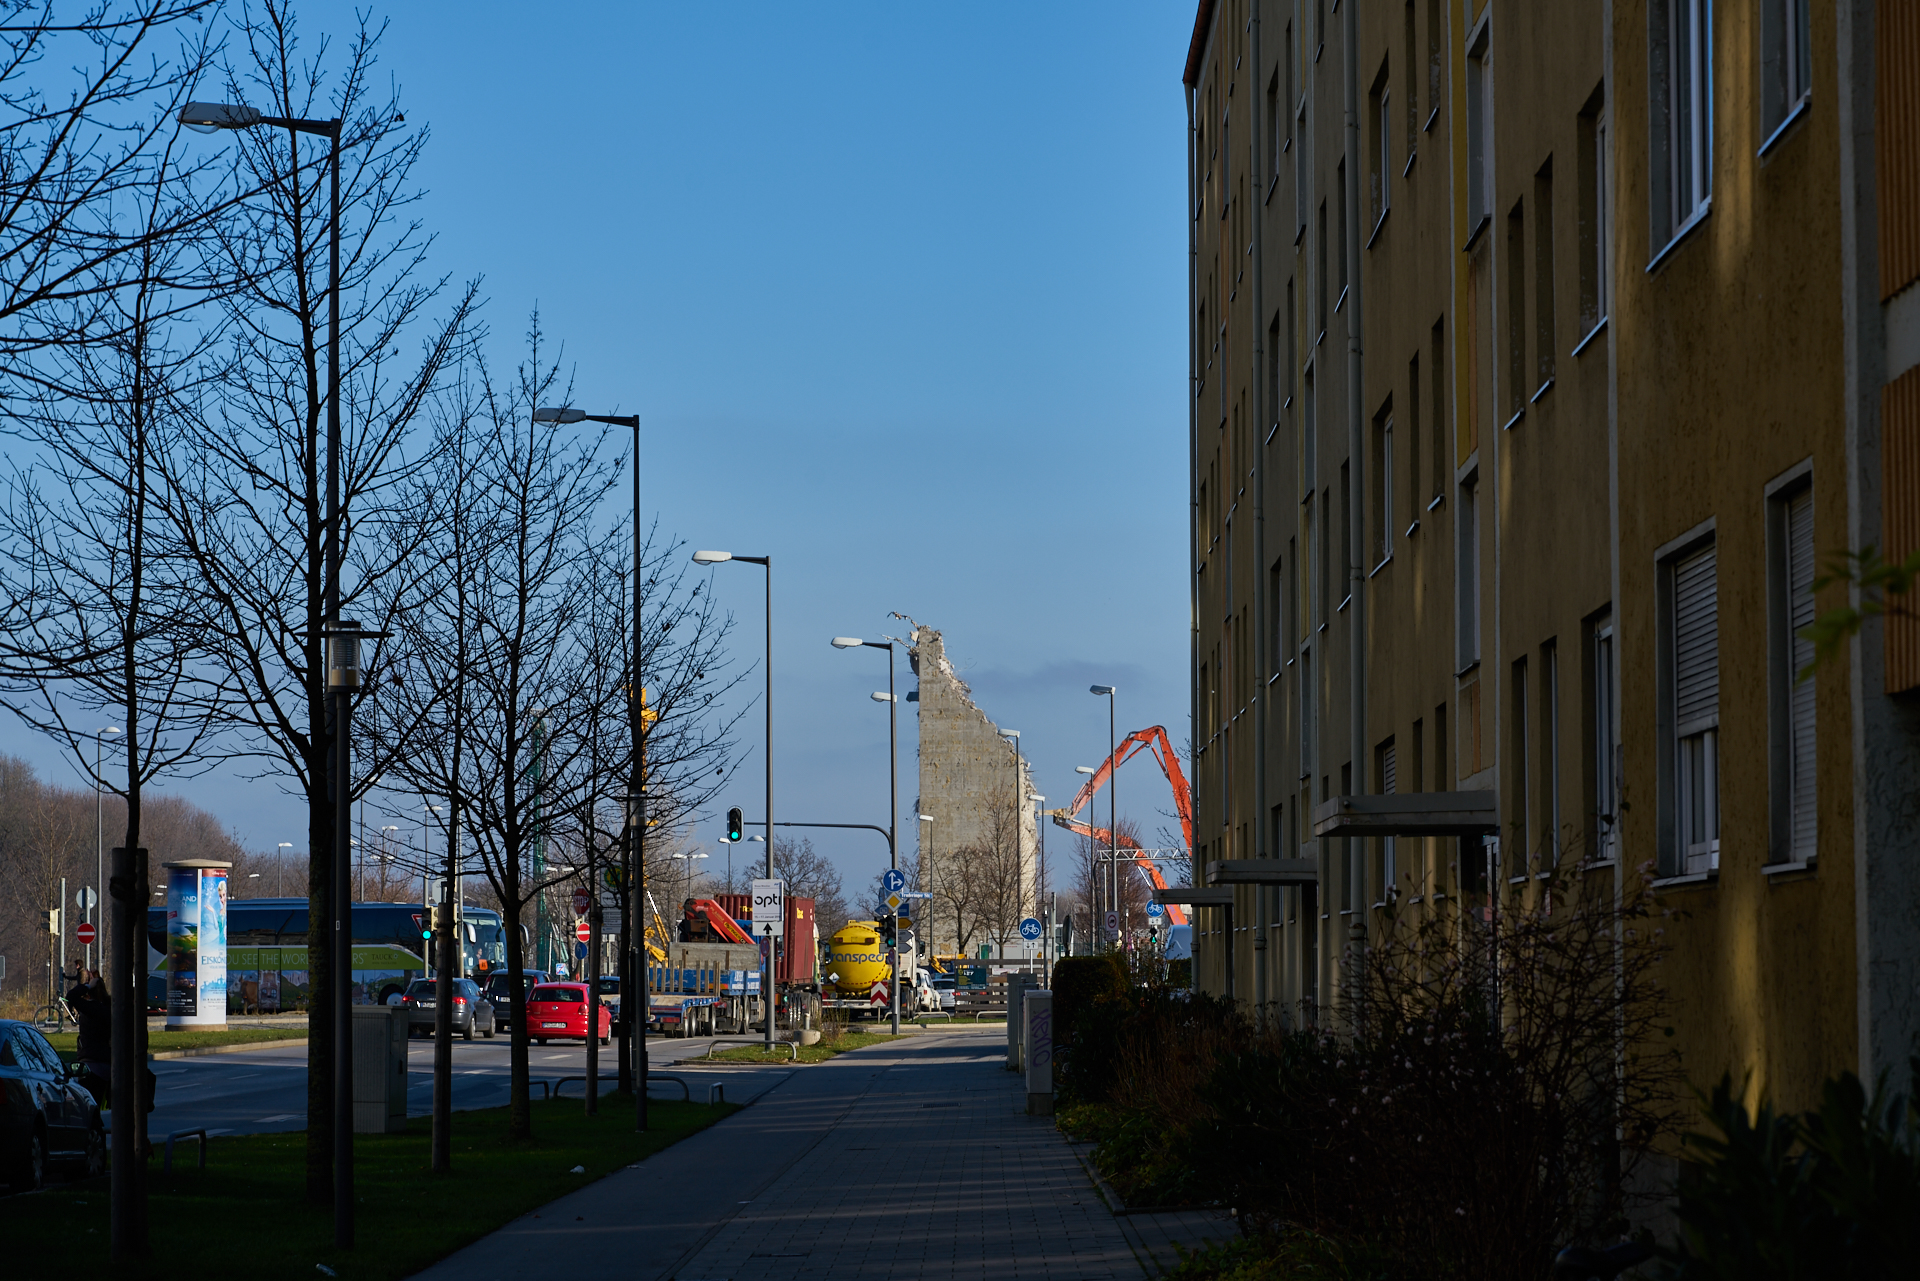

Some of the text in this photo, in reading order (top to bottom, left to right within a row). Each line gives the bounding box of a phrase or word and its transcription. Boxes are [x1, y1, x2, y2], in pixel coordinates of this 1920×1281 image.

[573, 896, 590, 907] STOP
[754, 893, 781, 908] opti
[241, 954, 258, 965] SEE
[262, 954, 279, 965] THE
[831, 953, 885, 964] ransped
